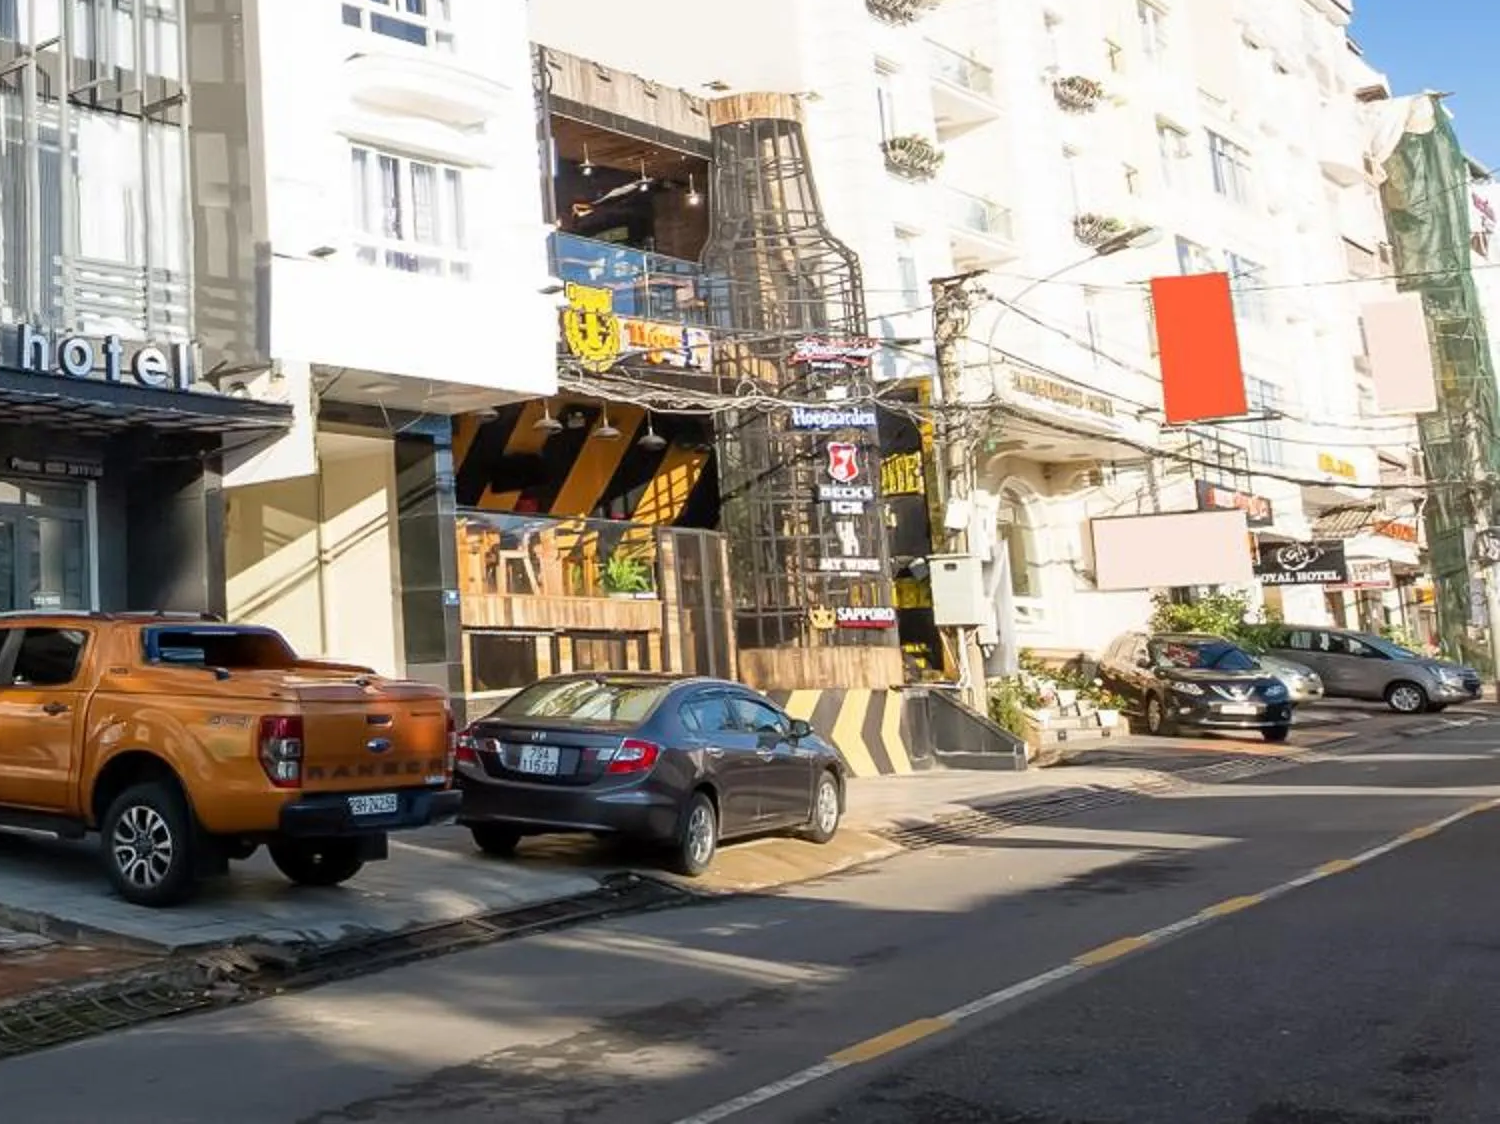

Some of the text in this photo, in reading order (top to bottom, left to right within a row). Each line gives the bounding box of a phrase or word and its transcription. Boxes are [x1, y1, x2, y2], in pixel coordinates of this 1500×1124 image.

[18, 323, 193, 391] hotel
[792, 407, 876, 429] Hoegaarden
[831, 500, 864, 514] ICE
[1259, 572, 1295, 583] OYAL
[1296, 571, 1342, 582] HOTEL
[837, 606, 896, 622] SAPPORO
